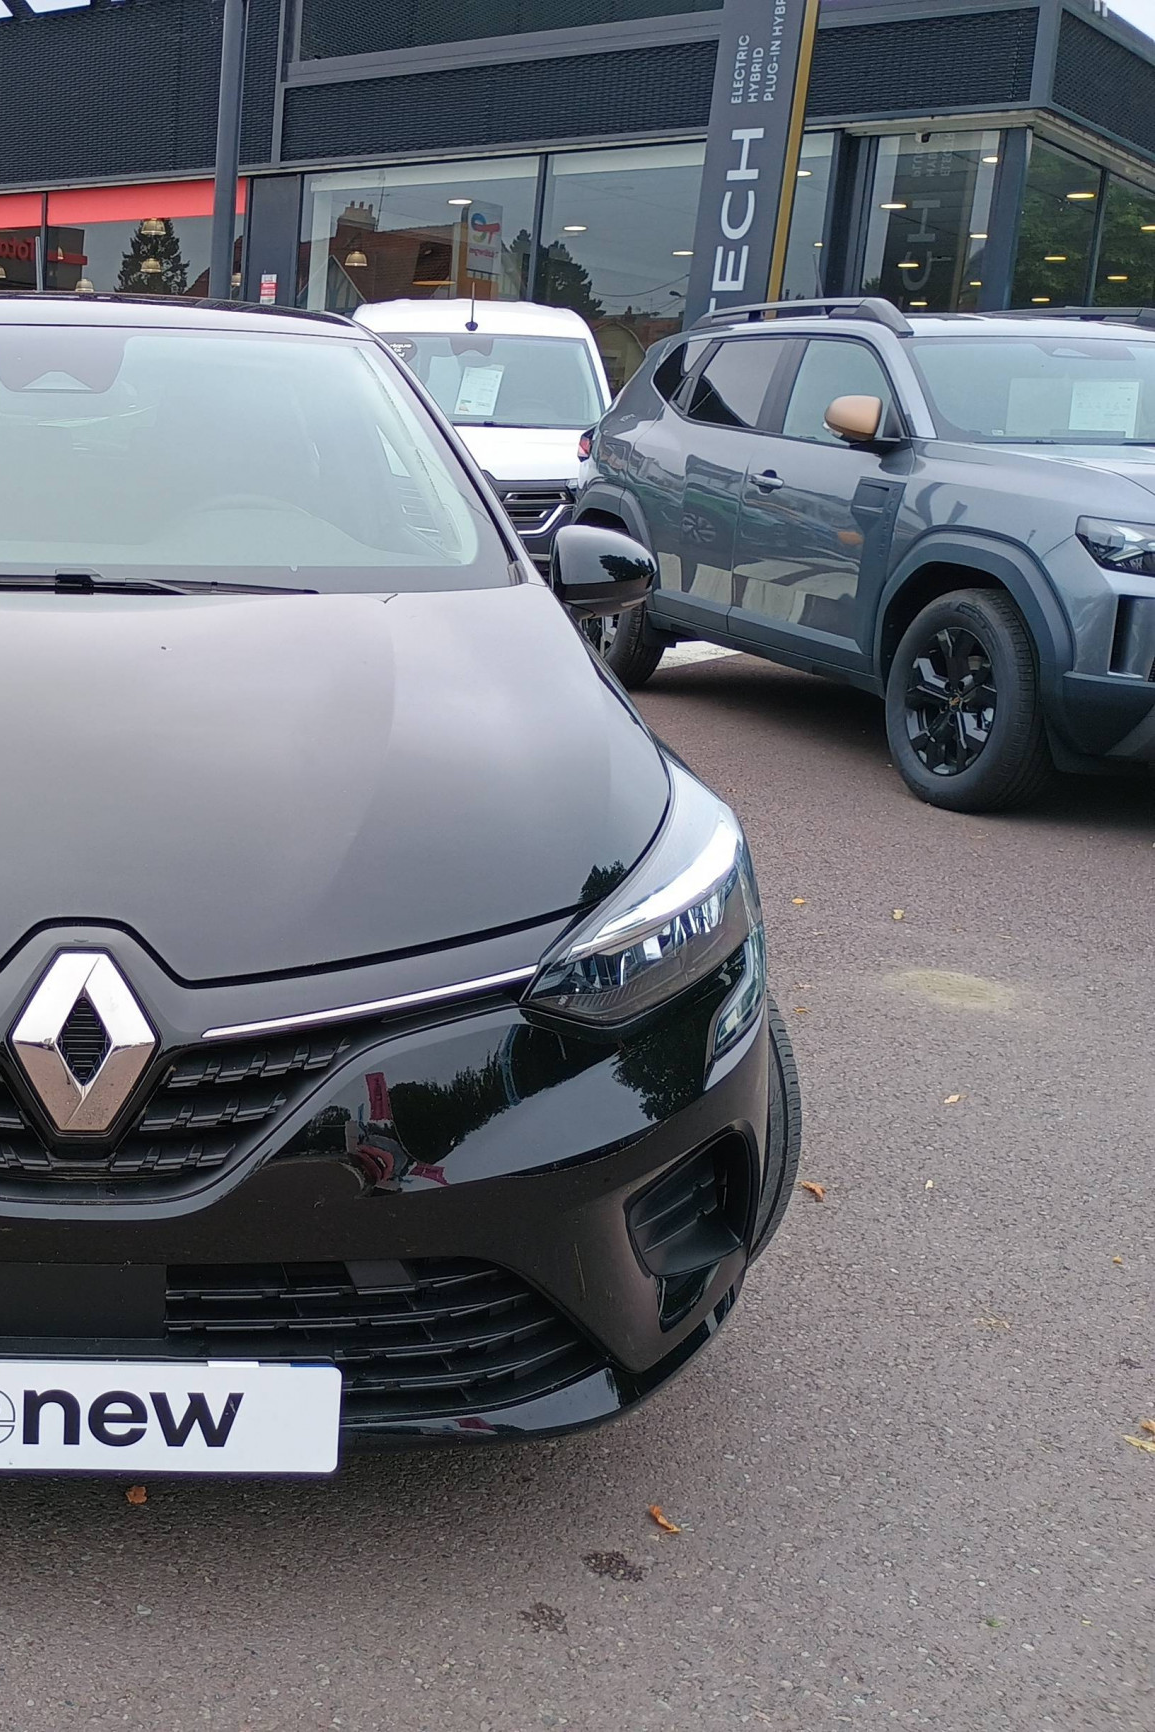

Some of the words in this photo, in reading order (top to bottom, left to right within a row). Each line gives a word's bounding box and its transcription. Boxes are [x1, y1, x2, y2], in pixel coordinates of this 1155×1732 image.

[772, 0, 786, 36] HYBR
[730, 34, 751, 104] ELECTRIC
[747, 47, 764, 103] HYBRID
[763, 40, 782, 102] PLUG-IN
[708, 127, 765, 317] ECH
